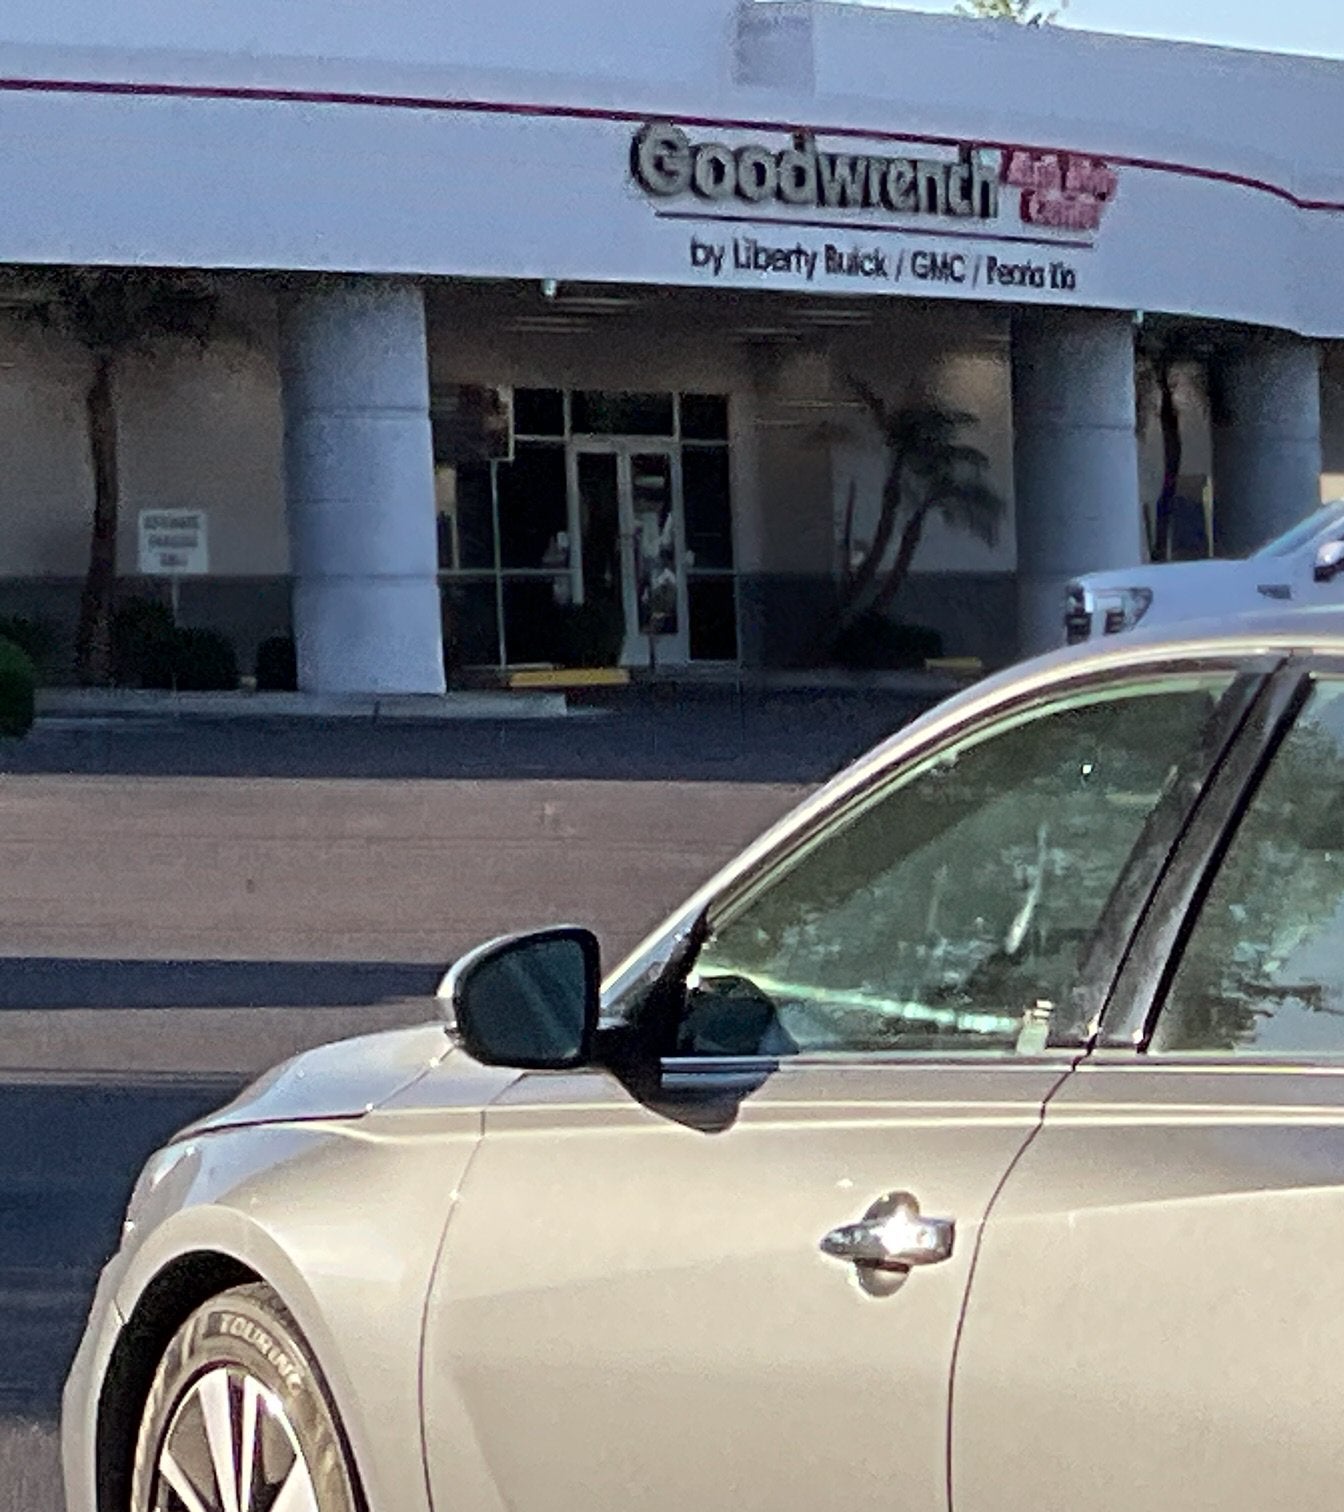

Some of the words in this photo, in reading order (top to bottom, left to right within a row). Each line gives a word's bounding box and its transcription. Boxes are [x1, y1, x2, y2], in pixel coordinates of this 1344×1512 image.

[630, 122, 999, 219] Goodwrench
[690, 236, 725, 276] by
[733, 236, 817, 281] Liberty
[824, 243, 887, 279] Buick
[911, 250, 967, 284] GMC
[220, 1313, 303, 1397] TOURING
